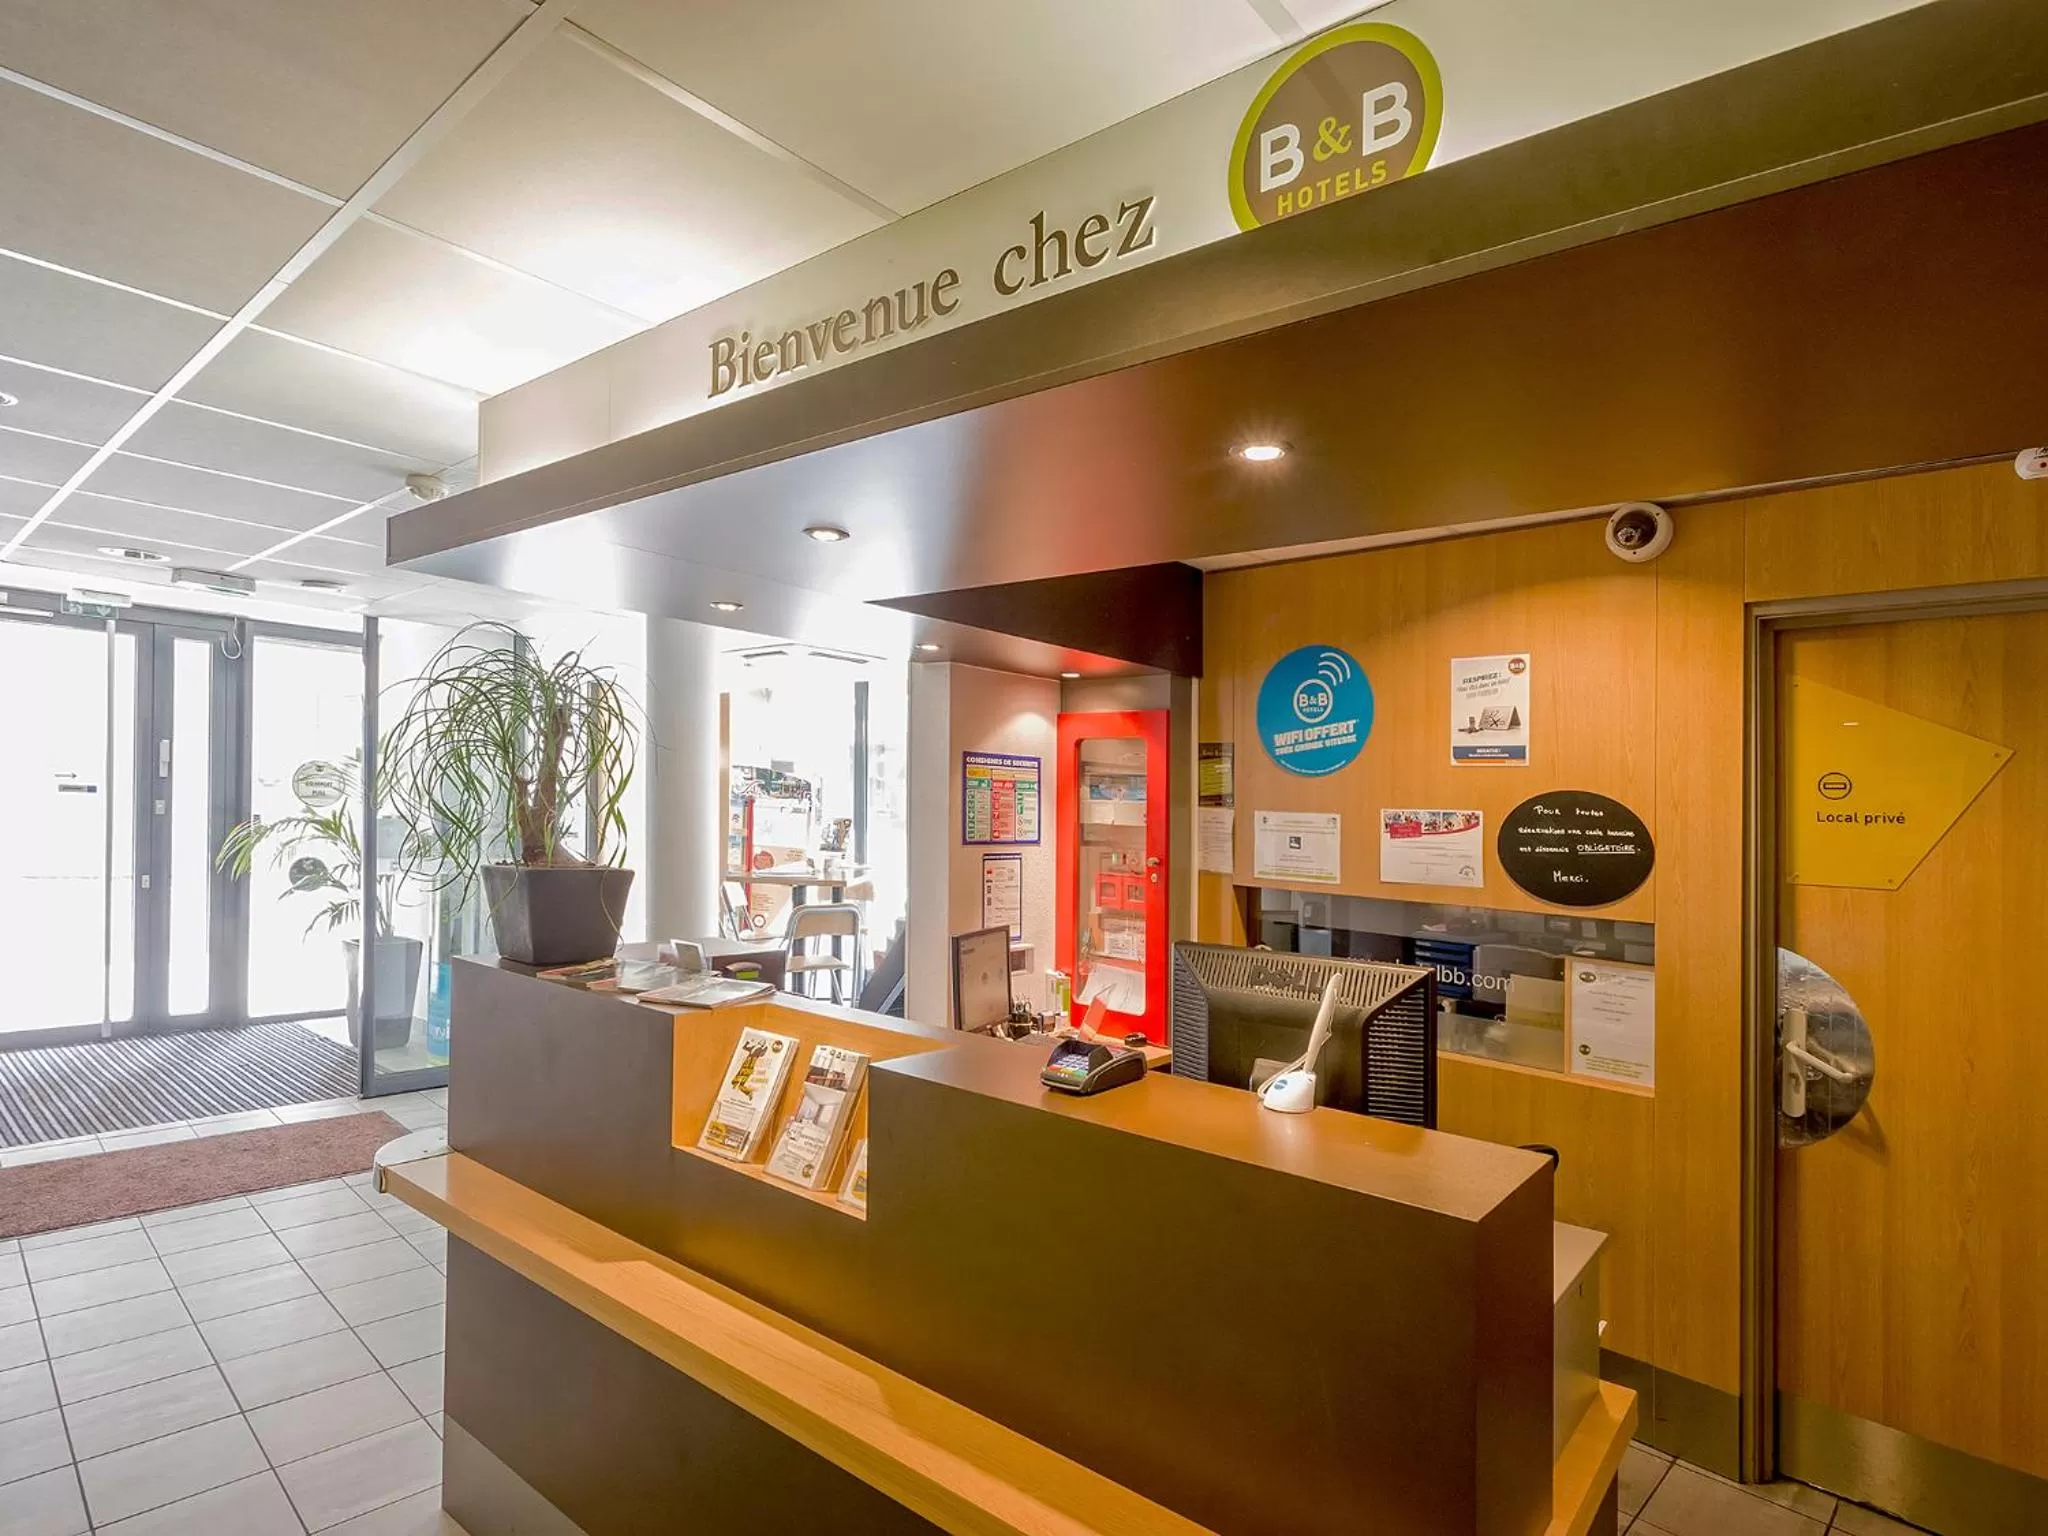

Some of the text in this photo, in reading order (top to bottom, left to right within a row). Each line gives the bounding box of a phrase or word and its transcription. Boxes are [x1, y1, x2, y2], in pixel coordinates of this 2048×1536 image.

[1260, 82, 1412, 193] B&B
[1277, 160, 1387, 216] HOTELS
[708, 195, 1155, 399] Bienvenue chez
[1274, 729, 1304, 747] WIFI
[1816, 811, 1906, 826] Local privé
